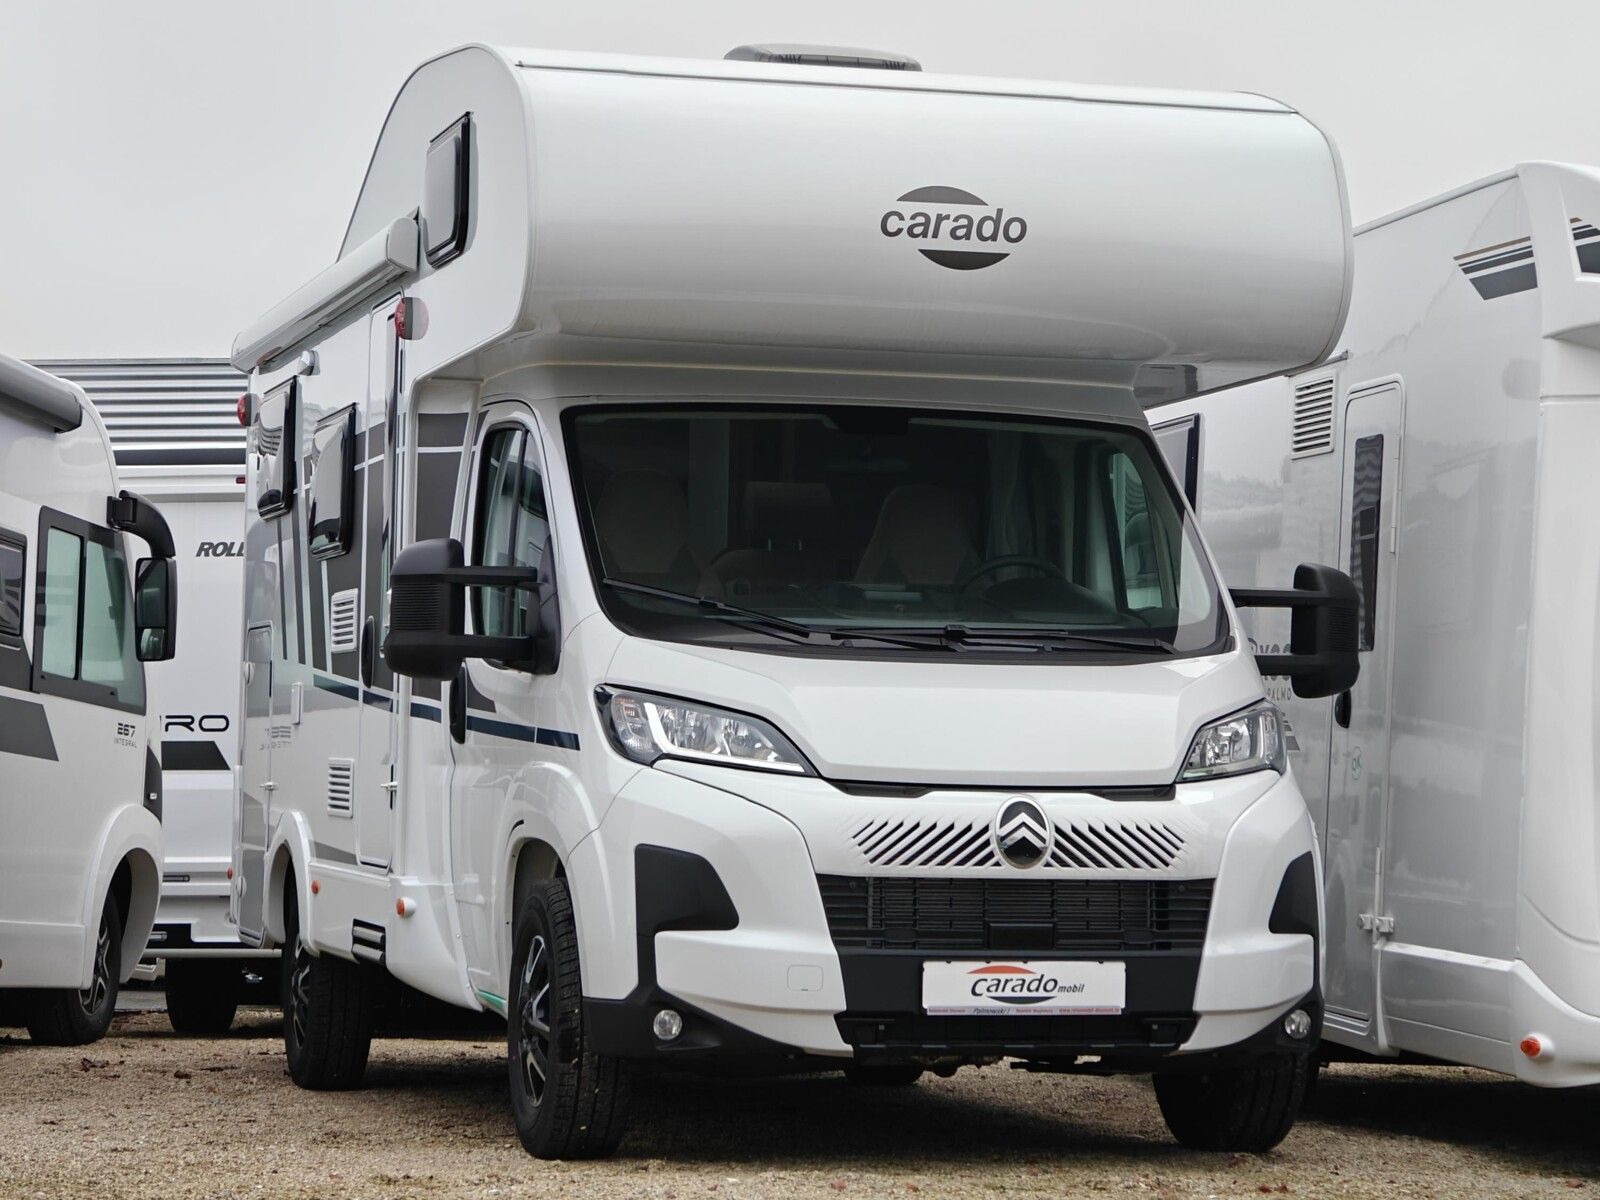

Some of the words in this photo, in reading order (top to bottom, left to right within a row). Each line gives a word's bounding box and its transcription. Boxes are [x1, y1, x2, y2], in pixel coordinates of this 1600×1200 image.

[880, 207, 1027, 244] carado
[117, 722, 136, 738] 267
[114, 737, 137, 749] INTEGRAL
[971, 973, 1058, 997] carado
[1057, 983, 1085, 993] mobil
